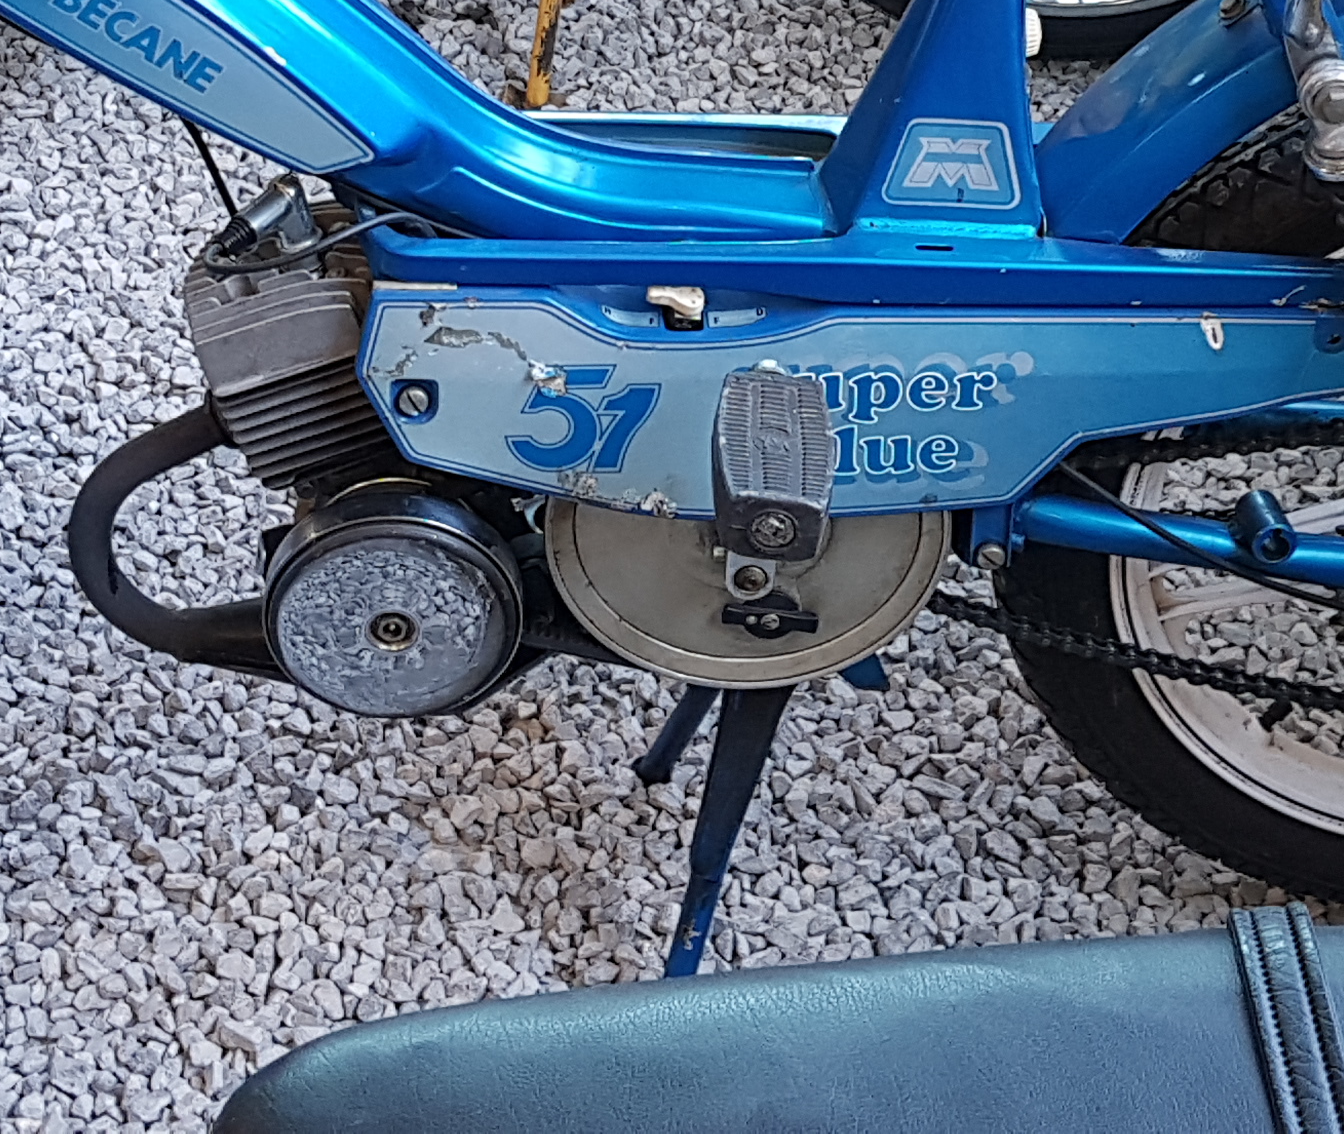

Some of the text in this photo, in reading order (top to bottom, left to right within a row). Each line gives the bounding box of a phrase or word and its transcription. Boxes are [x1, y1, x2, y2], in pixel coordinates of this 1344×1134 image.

[504, 364, 662, 473] 51
[793, 370, 997, 424] uper
[828, 424, 958, 475] lue
